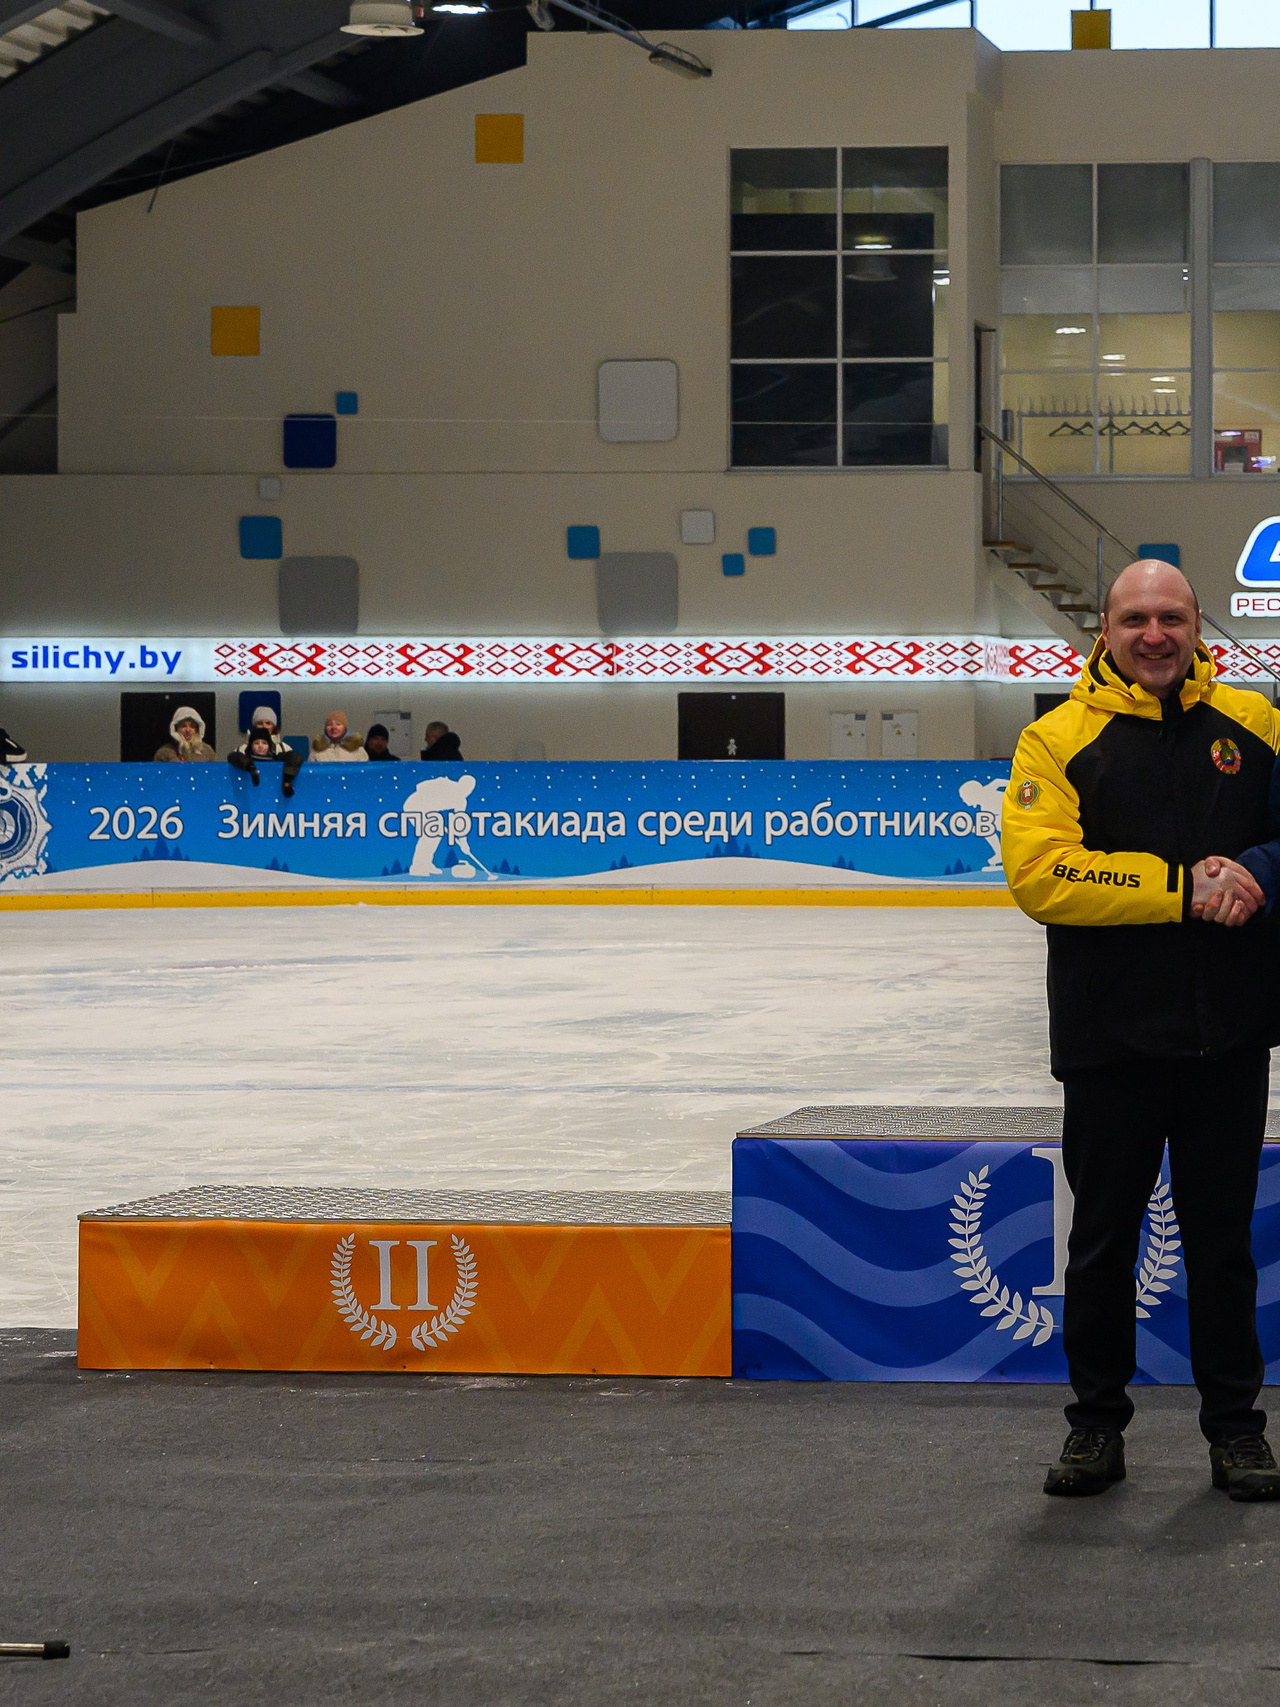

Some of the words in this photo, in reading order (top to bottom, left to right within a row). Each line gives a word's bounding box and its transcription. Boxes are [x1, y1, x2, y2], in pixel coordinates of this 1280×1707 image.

[11, 645, 182, 675] silichy.by
[88, 806, 184, 840] 2026
[217, 805, 367, 839] Зимняя
[378, 810, 626, 846] спартакиада
[637, 811, 753, 845] среди
[764, 799, 996, 844] работников
[1052, 864, 1141, 888] BELARUS
[368, 1240, 439, 1310] II
